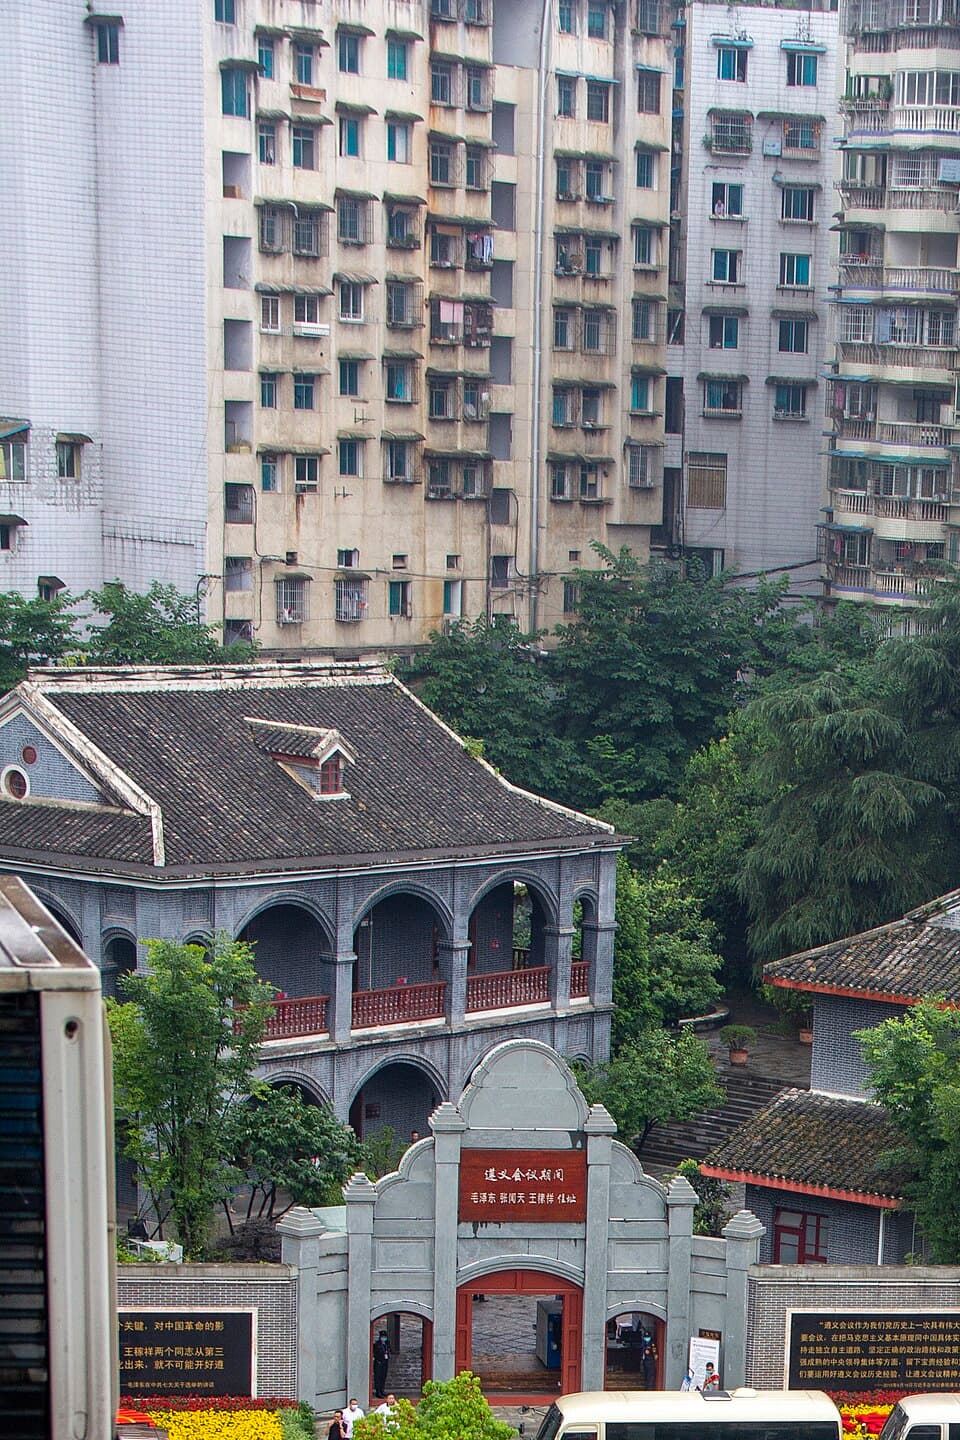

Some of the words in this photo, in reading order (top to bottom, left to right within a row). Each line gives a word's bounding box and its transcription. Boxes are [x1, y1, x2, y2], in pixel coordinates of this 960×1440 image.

[484, 1167, 564, 1182] 遵义会议期间
[470, 1192, 496, 1204] 毛泽东
[500, 1192, 525, 1204] 张闻天
[528, 1192, 554, 1204] 王稼祥
